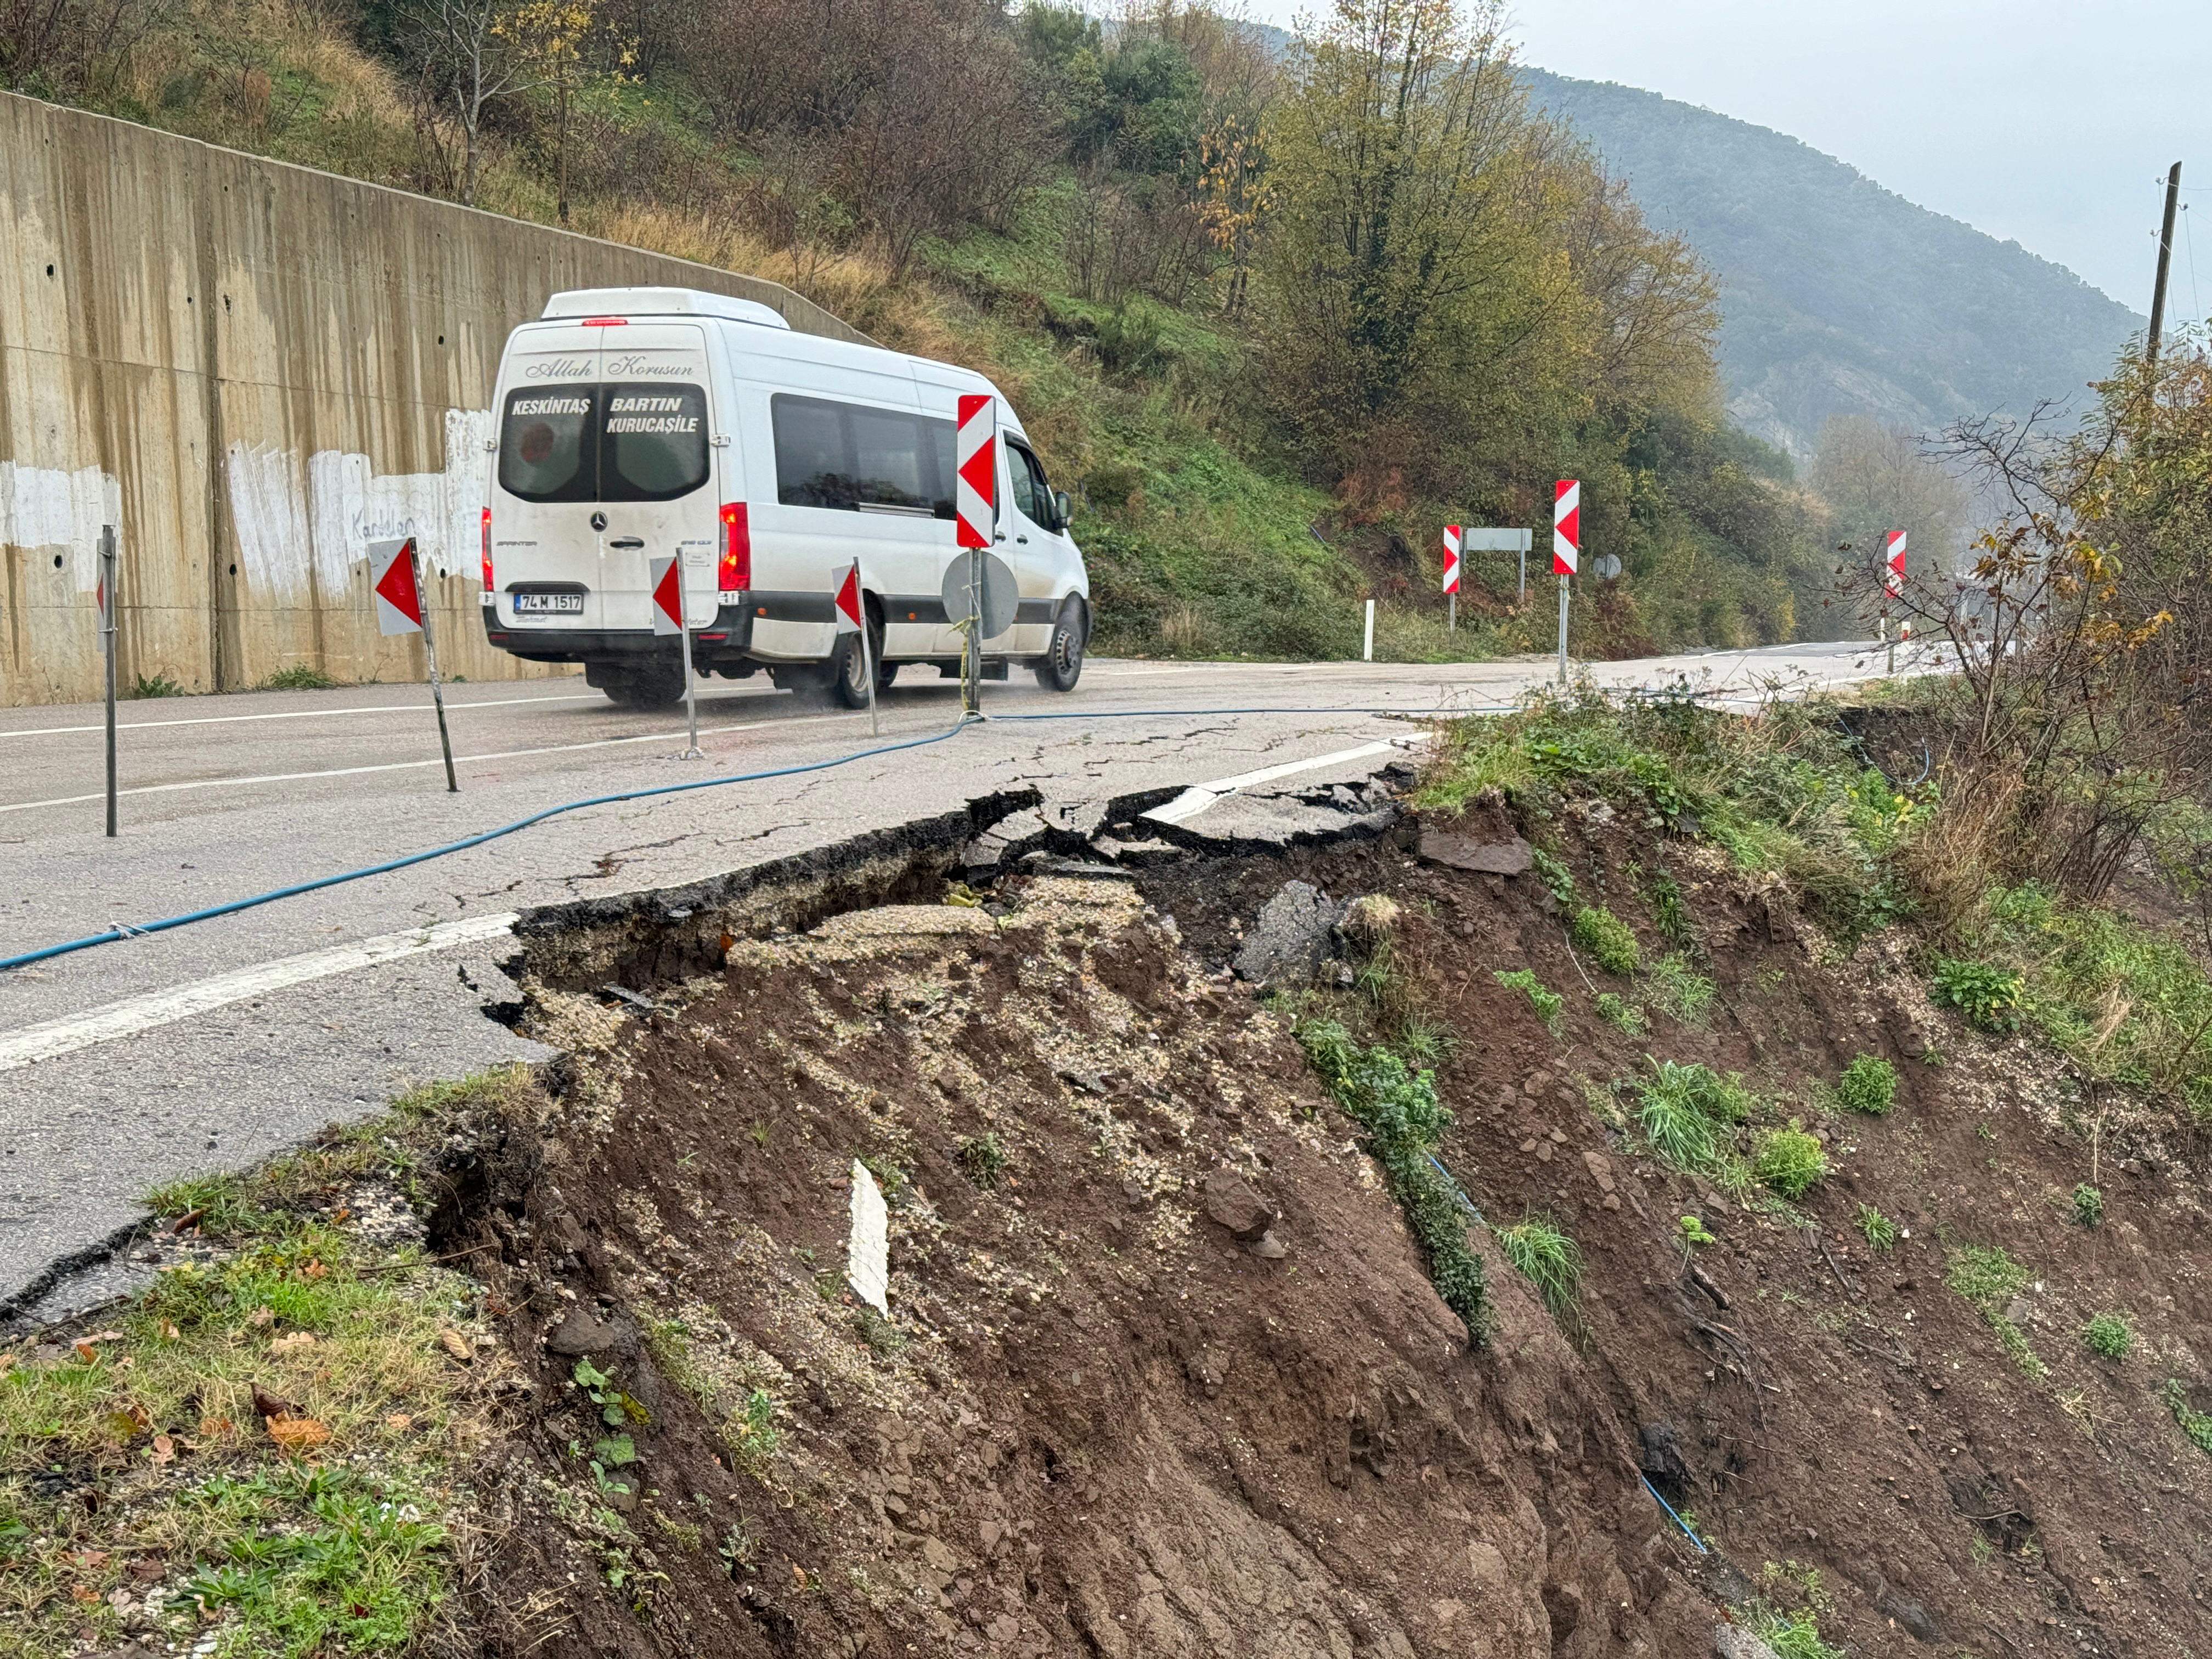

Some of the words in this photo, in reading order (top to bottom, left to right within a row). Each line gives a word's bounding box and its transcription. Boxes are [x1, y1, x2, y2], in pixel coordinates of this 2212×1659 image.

[526, 358, 592, 378] Allah
[608, 356, 694, 375] Korusun
[511, 396, 591, 415] KESKİNTAŞ
[610, 397, 682, 412] BARTIN
[606, 414, 699, 434] KURUCAŞİLE
[522, 596, 537, 608] 74
[540, 596, 549, 608] M
[554, 596, 580, 608] 1517
